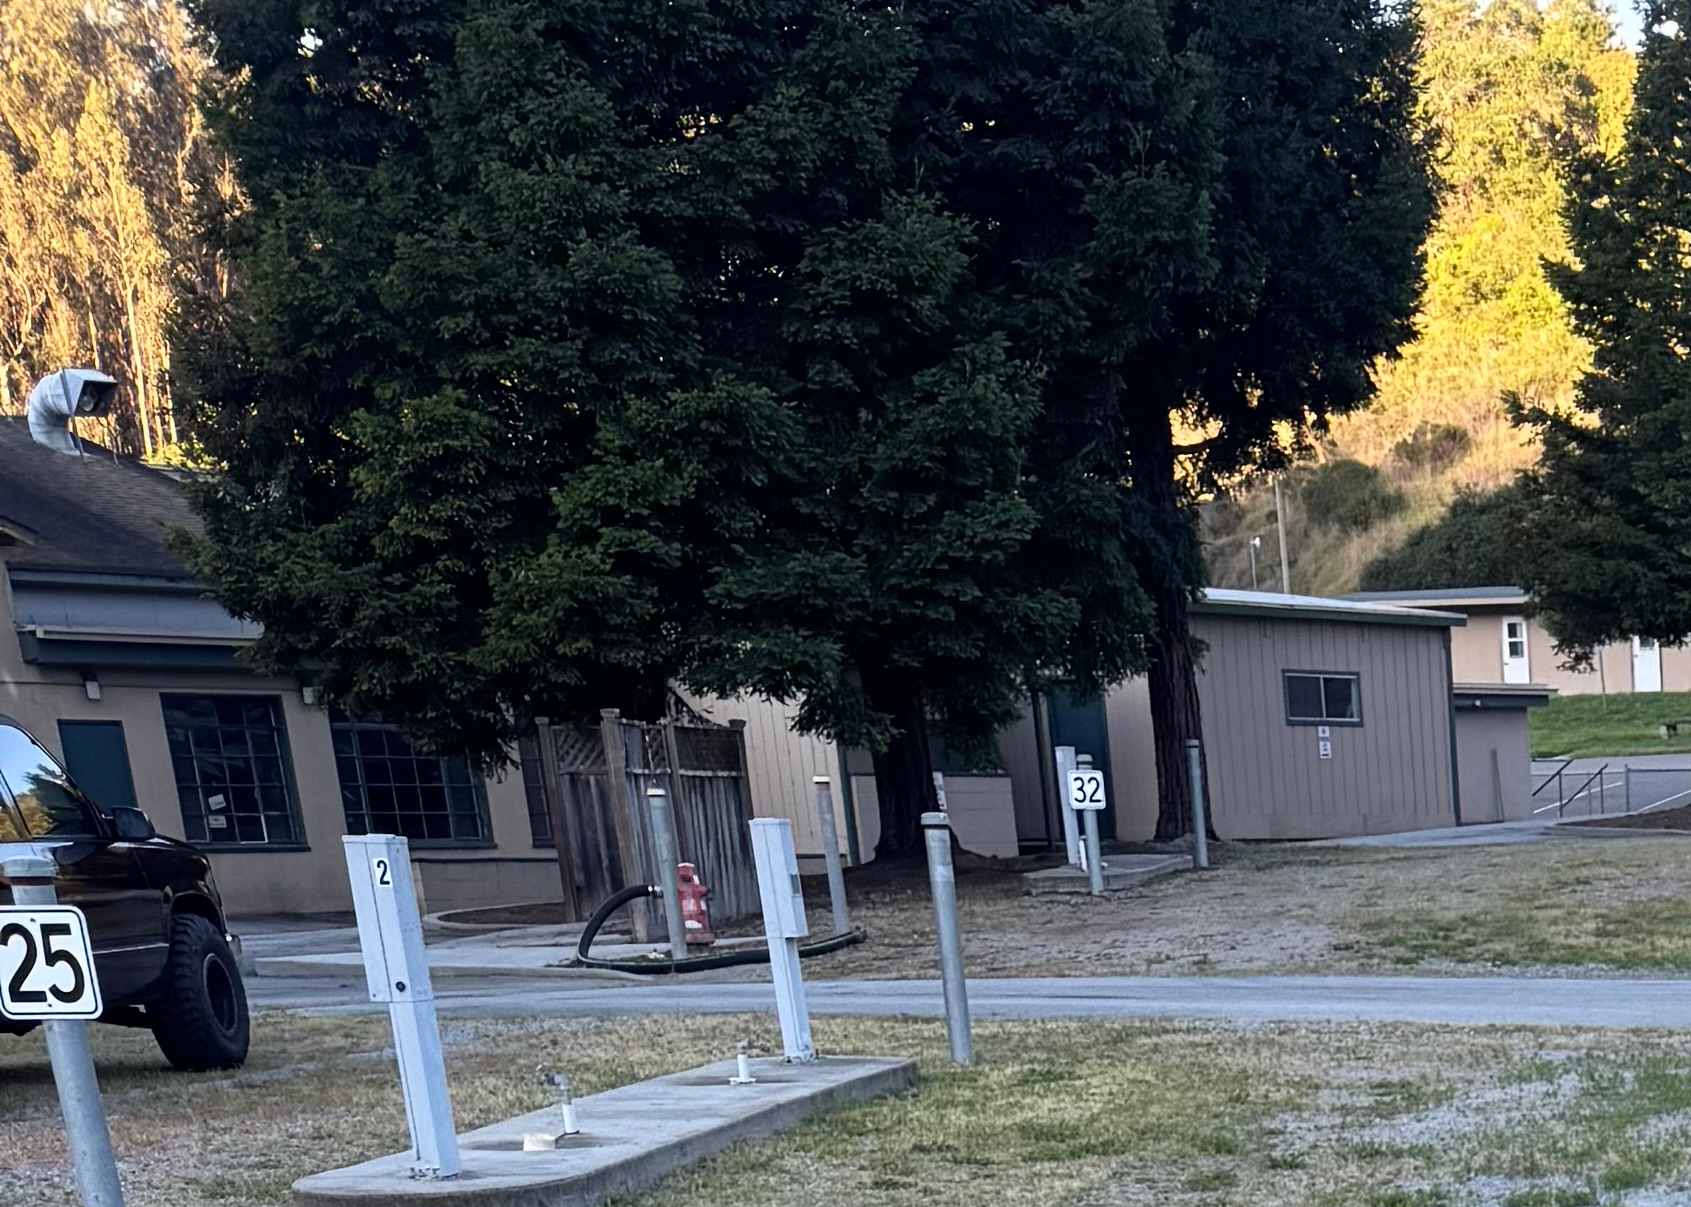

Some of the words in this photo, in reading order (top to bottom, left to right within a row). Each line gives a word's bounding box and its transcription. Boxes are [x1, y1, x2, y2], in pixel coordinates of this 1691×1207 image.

[1073, 776, 1102, 803] 32
[376, 859, 390, 885] 2
[0, 922, 85, 1003] 25
